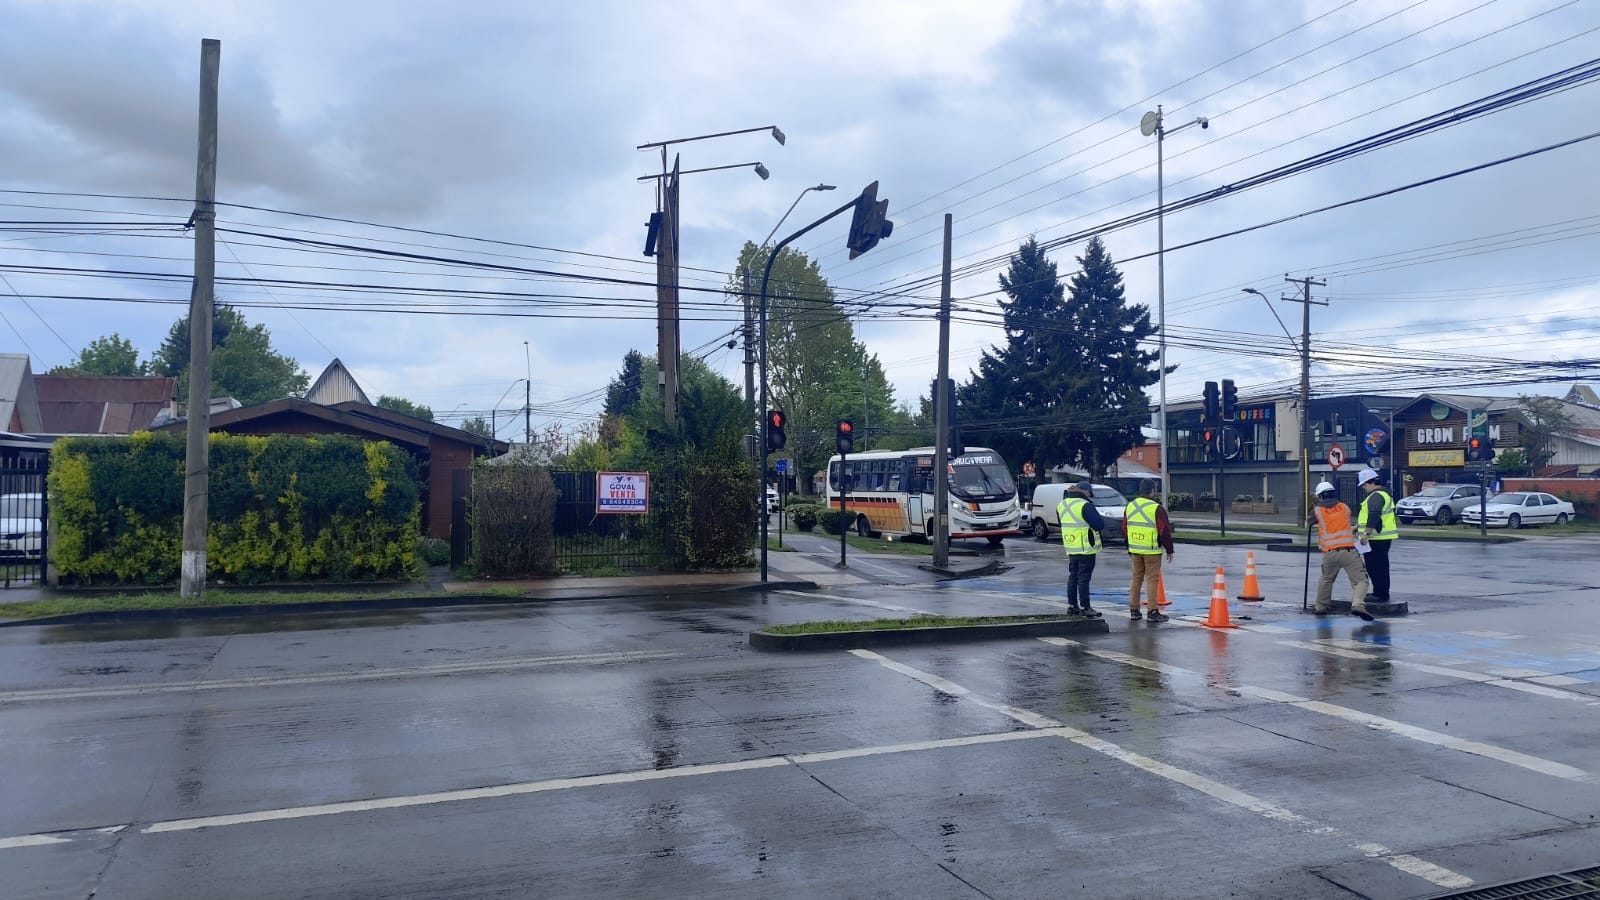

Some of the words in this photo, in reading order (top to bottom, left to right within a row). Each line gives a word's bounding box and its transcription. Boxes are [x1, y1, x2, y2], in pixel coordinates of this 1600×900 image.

[1417, 427, 1453, 444] GROW
[1462, 425, 1501, 443] FM
[609, 490, 636, 498] VENTA
